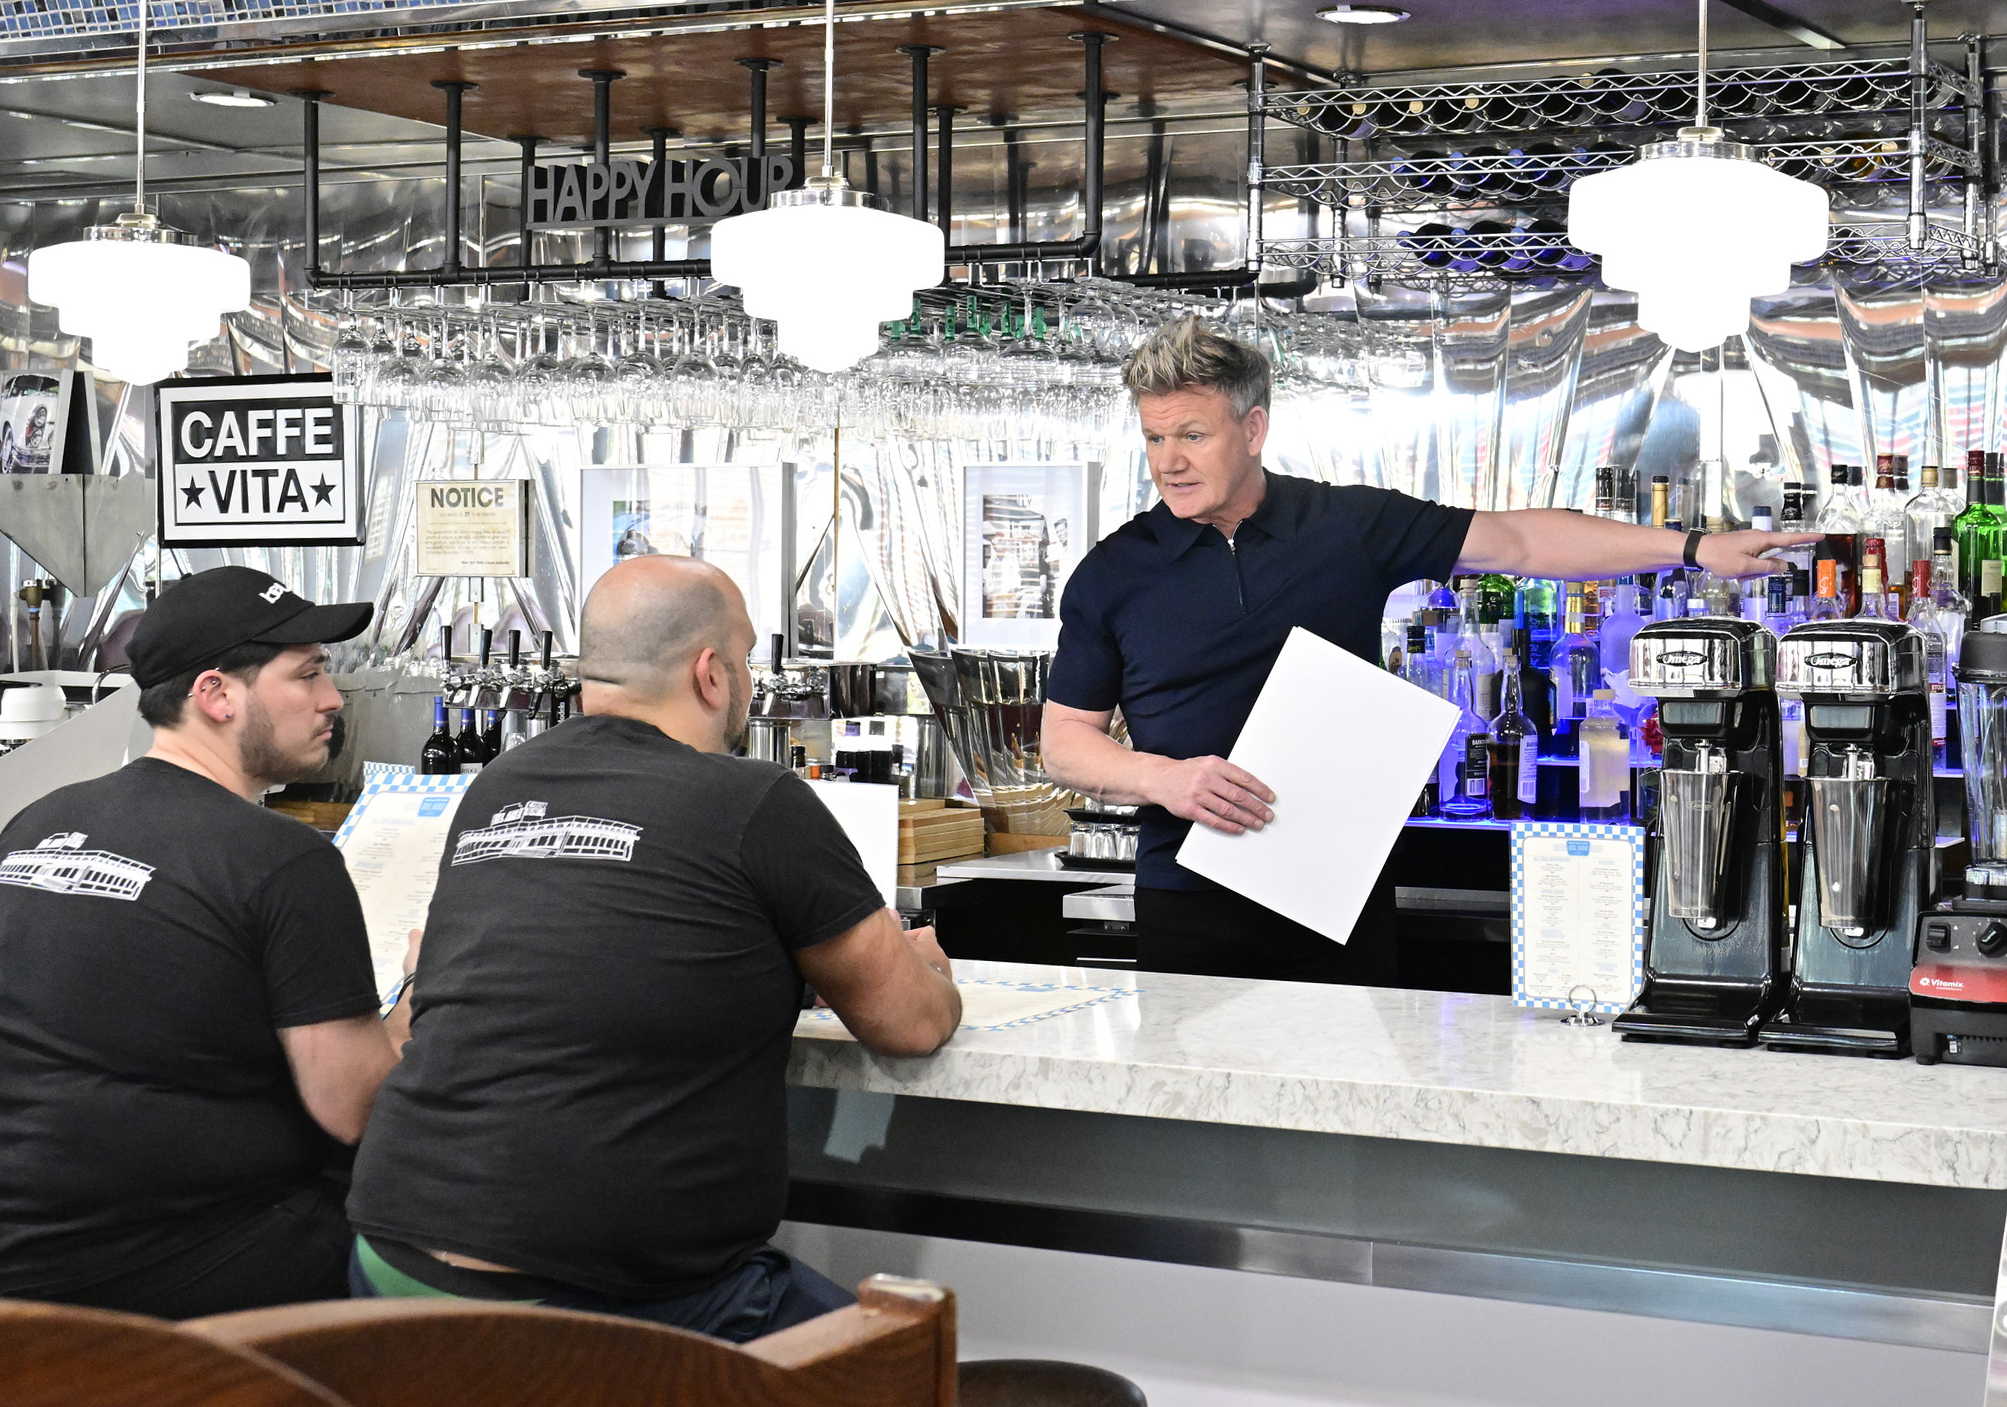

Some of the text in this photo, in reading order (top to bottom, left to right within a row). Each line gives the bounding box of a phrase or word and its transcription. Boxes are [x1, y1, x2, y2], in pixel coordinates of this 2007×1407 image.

[528, 160, 658, 222] HAPPY
[181, 407, 333, 458] CAFFE
[208, 468, 309, 514] VITA
[431, 487, 504, 508] NOTICE
[1663, 652, 1703, 666] Omega
[1810, 654, 1850, 668] Omega
[1931, 979, 1963, 987] Vitamix
